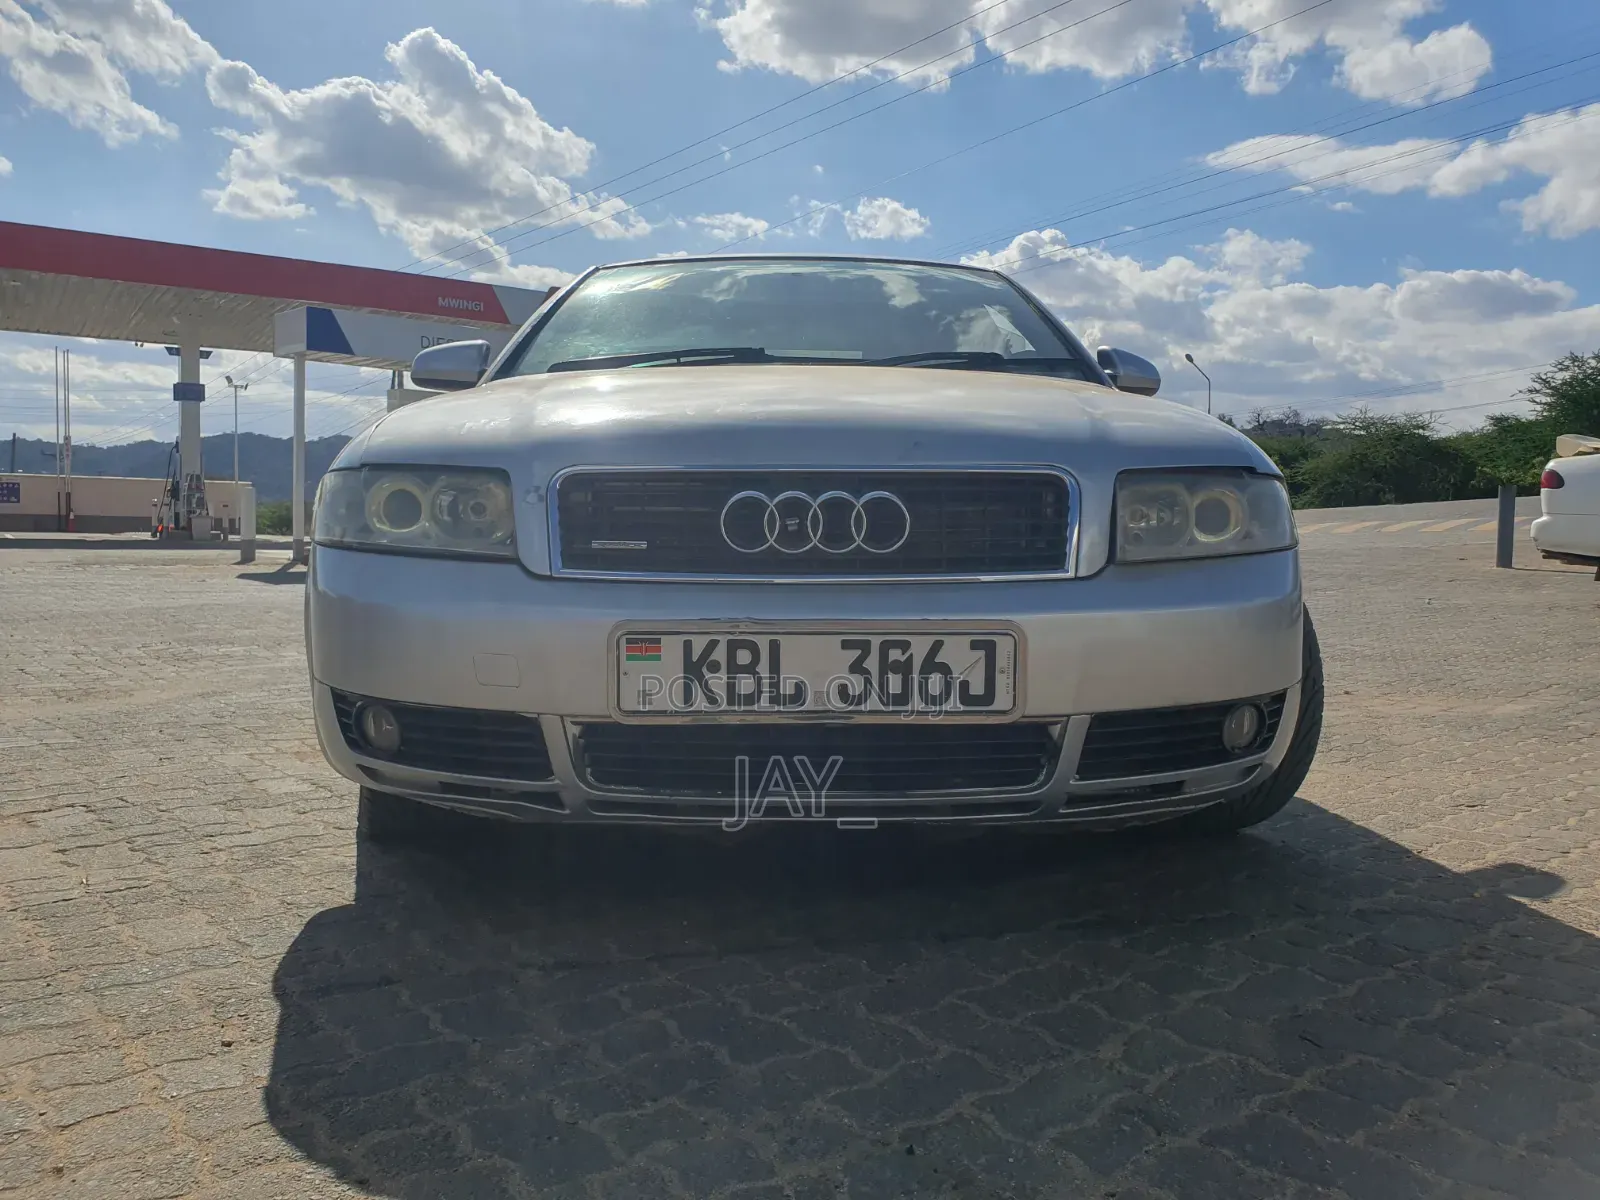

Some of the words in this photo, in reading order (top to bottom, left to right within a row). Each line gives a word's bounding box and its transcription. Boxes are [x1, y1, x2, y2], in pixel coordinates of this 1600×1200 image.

[438, 297, 484, 311] MWINGI
[421, 335, 460, 349] DIE
[682, 638, 807, 707] KBL
